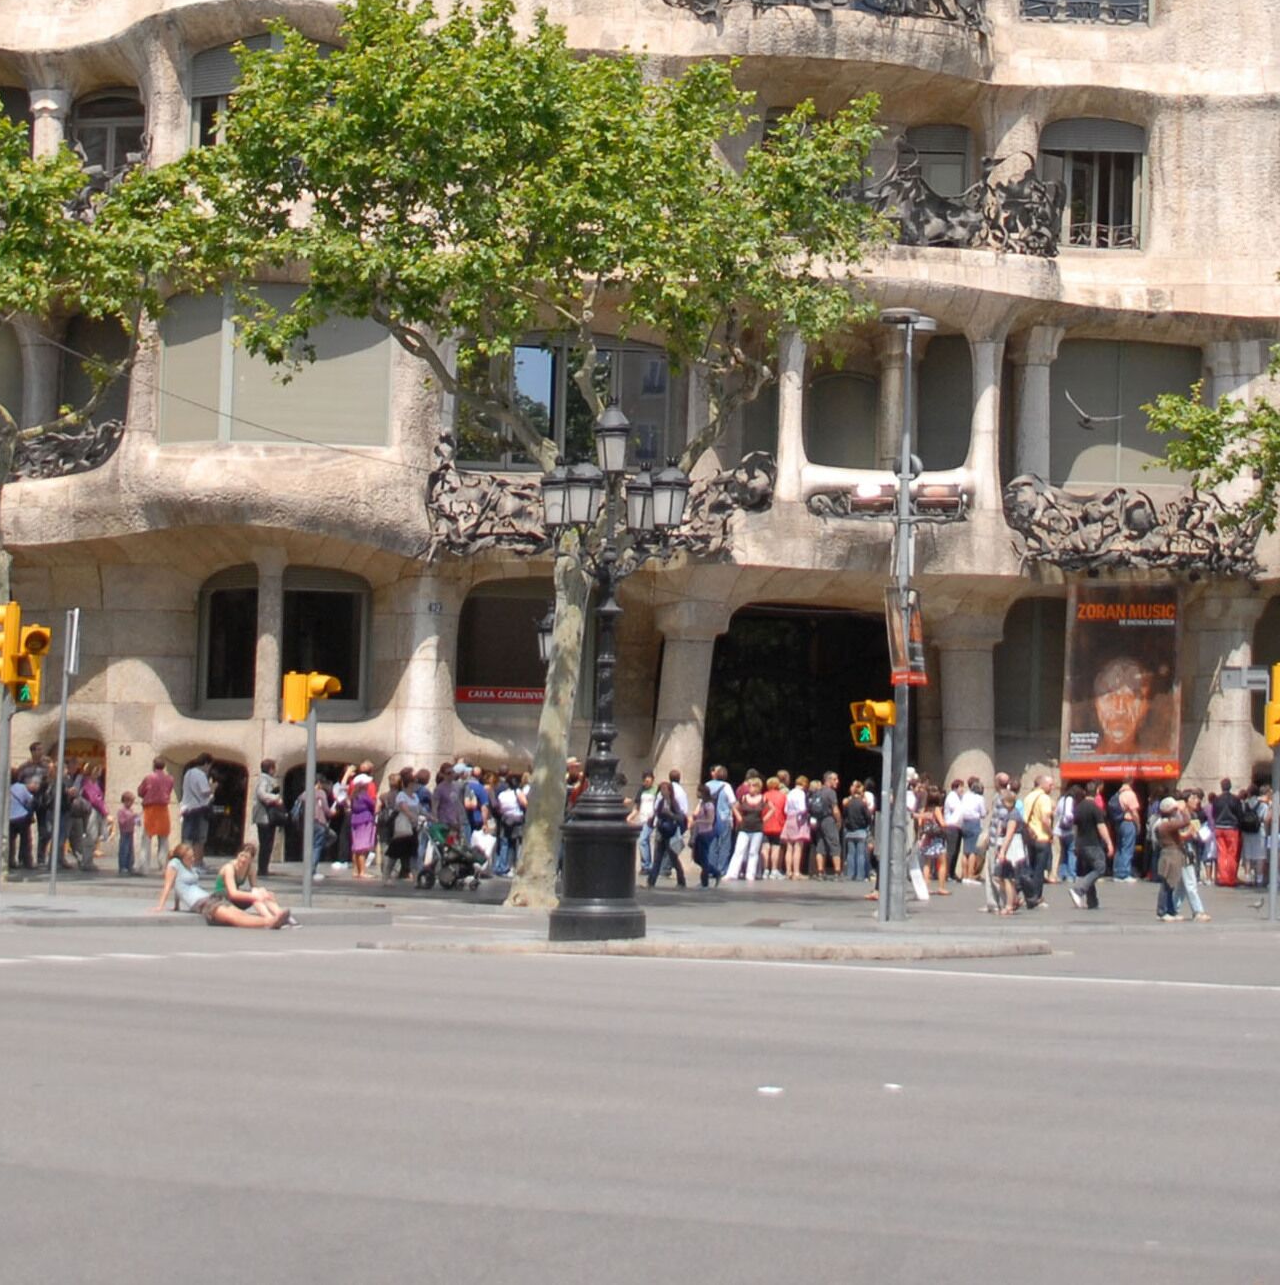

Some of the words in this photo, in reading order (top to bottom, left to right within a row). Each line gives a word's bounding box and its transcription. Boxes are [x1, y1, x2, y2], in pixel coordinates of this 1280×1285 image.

[1077, 602, 1126, 620] ZORAN
[1129, 602, 1176, 620] MUSIC
[467, 690, 495, 699] CAIXA
